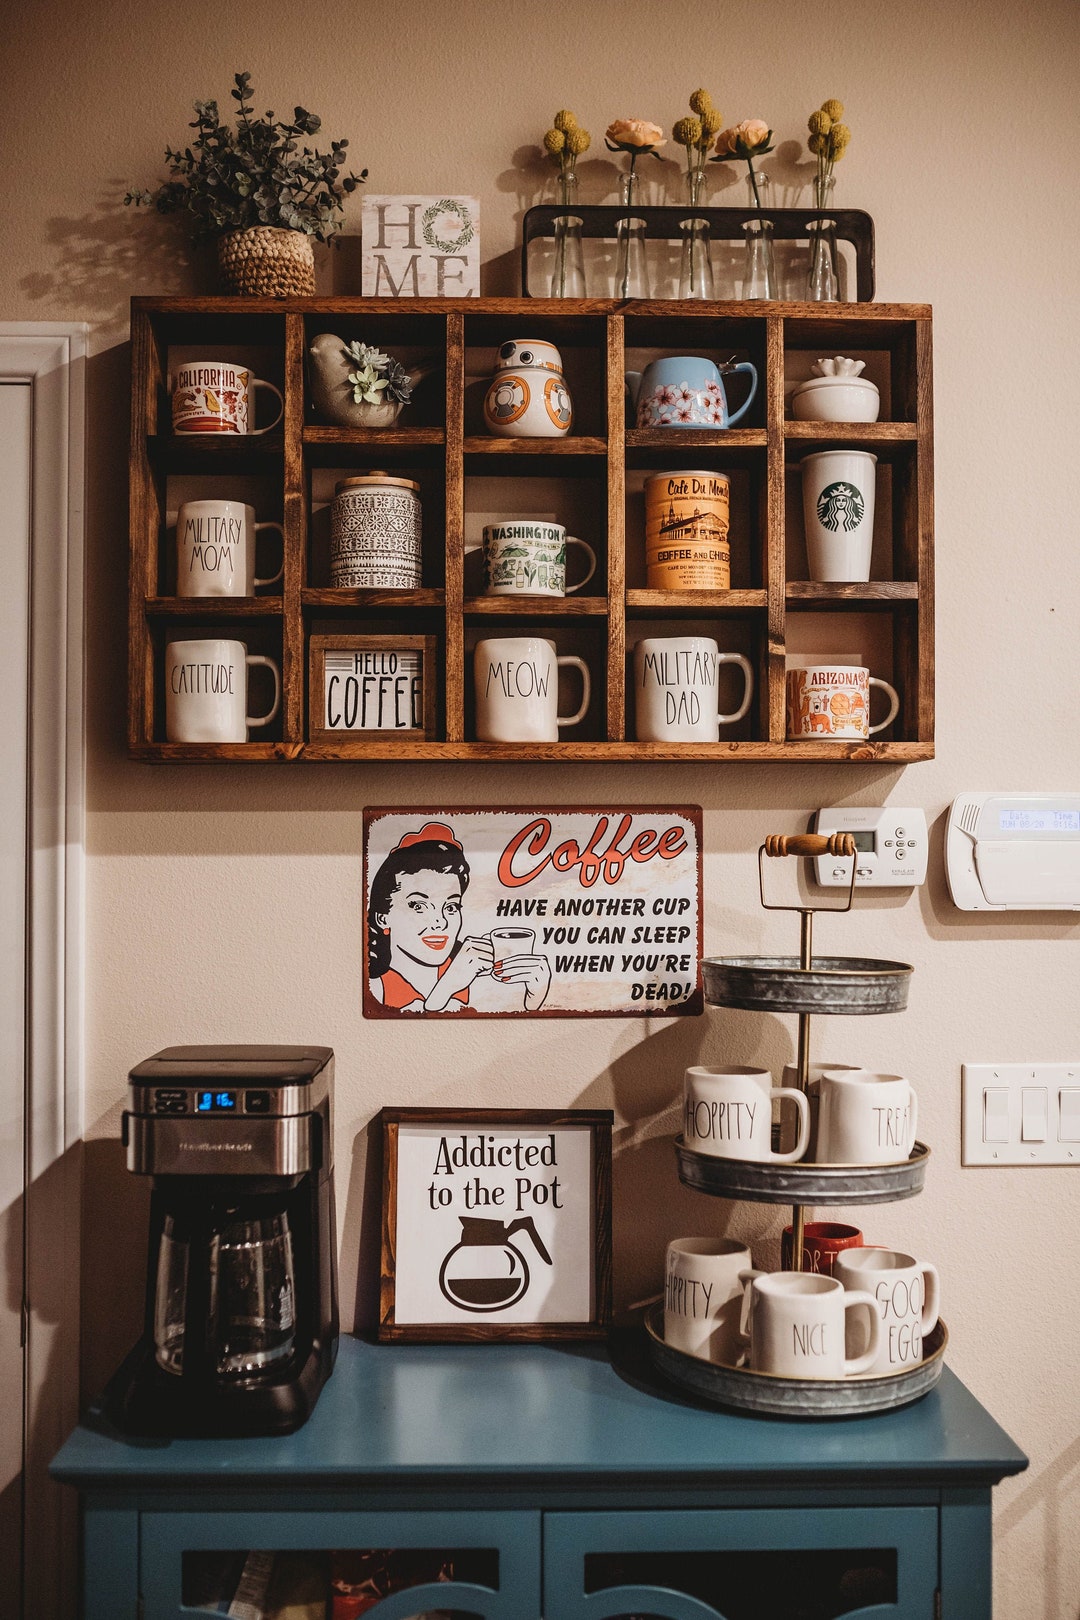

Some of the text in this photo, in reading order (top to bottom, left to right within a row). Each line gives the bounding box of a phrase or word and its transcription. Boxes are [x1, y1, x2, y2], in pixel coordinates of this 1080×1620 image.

[179, 369, 236, 389] CALIFORNIA
[667, 479, 689, 496] Café
[692, 478, 706, 495] Du
[183, 517, 242, 545] MILITARY
[492, 526, 560, 542] WASHINGTON
[190, 545, 234, 572] MOM
[658, 549, 692, 562] COFFEE
[693, 552, 708, 560] AND
[171, 664, 234, 694] CATITUDE
[355, 653, 398, 675] HELLO
[486, 661, 551, 698] MEOW
[642, 651, 717, 688] MILITARY
[811, 672, 859, 686] ARIZONA
[328, 676, 423, 728] COFFEE
[666, 691, 701, 725] DAD
[497, 814, 688, 888] Coffee
[496, 898, 691, 917] HAVE ANOTHER CUP
[542, 926, 691, 945] YOU CAN SLEEP
[555, 954, 690, 973] WHEN YOU'RE
[631, 982, 692, 1001] DEAD!
[685, 1101, 757, 1140] HOPPITY
[872, 1105, 910, 1147] TREA
[432, 1134, 558, 1175] Addicted
[428, 1176, 564, 1212] to the Pot
[665, 1277, 713, 1319] HIPPITY
[875, 1277, 921, 1320] GOO
[793, 1323, 827, 1357] NICE
[889, 1321, 920, 1363] EGG
